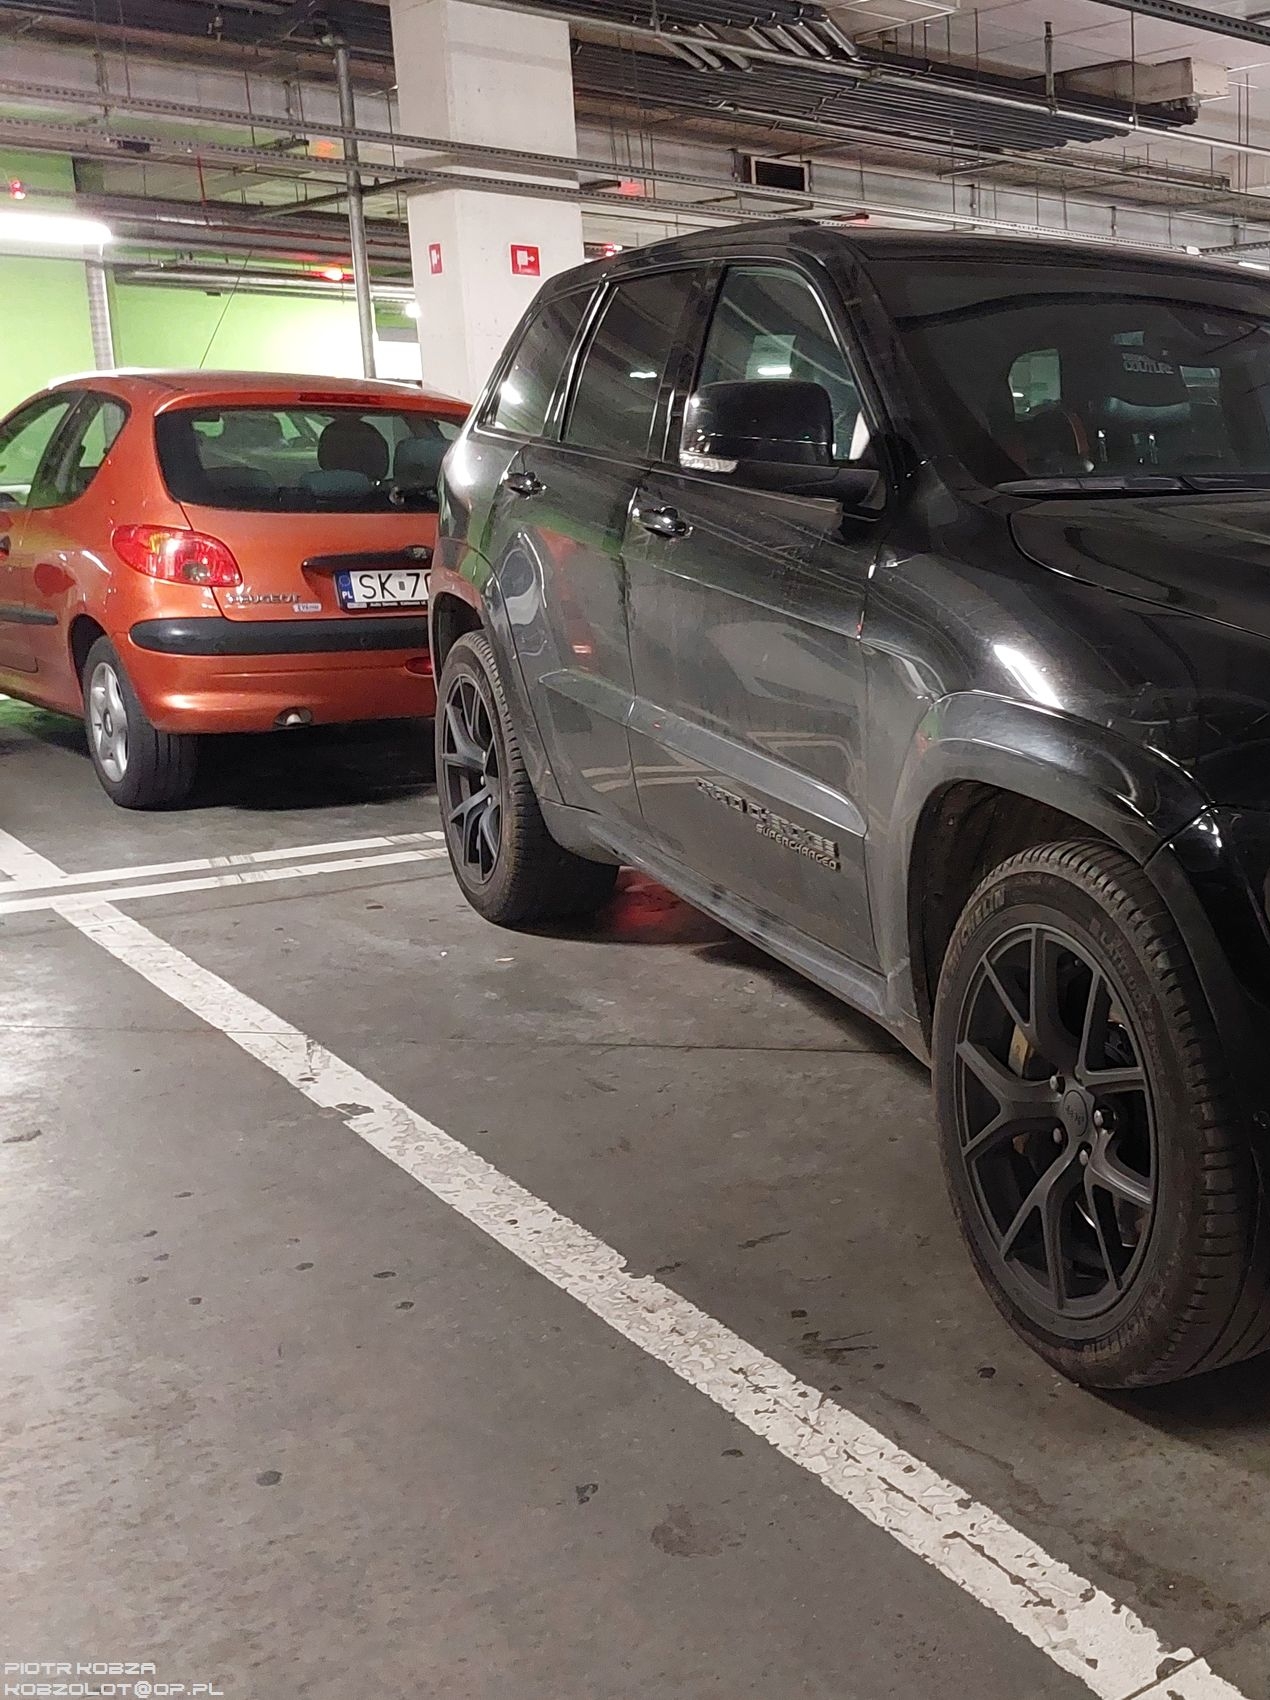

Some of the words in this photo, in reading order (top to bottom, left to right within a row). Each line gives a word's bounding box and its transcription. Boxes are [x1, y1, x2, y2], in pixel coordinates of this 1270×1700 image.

[342, 591, 353, 599] PL
[359, 573, 397, 599] SK
[755, 823, 840, 872] SUPERCHARGED
